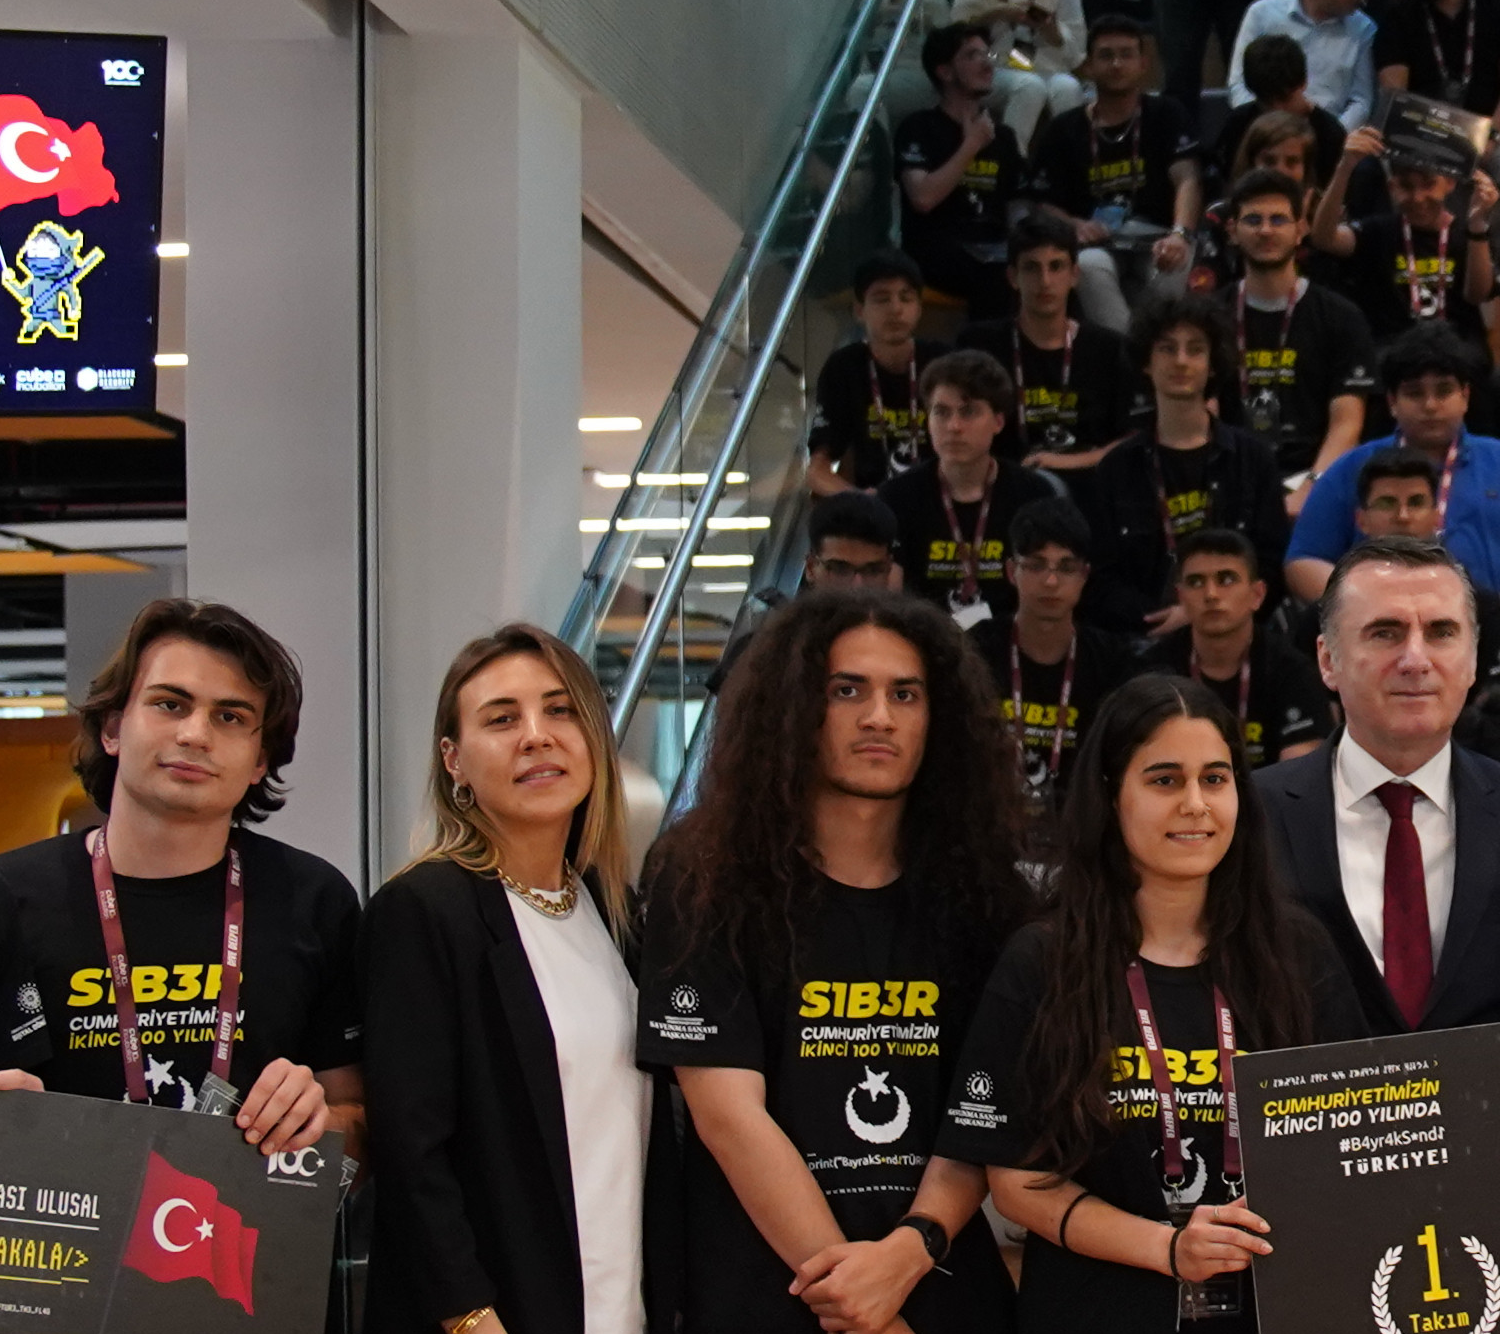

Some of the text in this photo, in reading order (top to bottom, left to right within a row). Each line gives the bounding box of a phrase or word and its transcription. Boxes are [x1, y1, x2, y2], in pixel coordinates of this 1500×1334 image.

[929, 540, 1003, 561] S1R
[799, 980, 940, 1018] S1B3R
[800, 1041, 880, 1057] İKİNCİ 100
[1263, 1078, 1440, 1117] CUMHURİYETİMİZİN
[1264, 1100, 1442, 1137] İKİNCİ 100 YILINDA
[36, 1190, 100, 1220] ULUSAL
[1417, 1224, 1460, 1302] 1.
[1409, 1311, 1470, 1334] Takım
